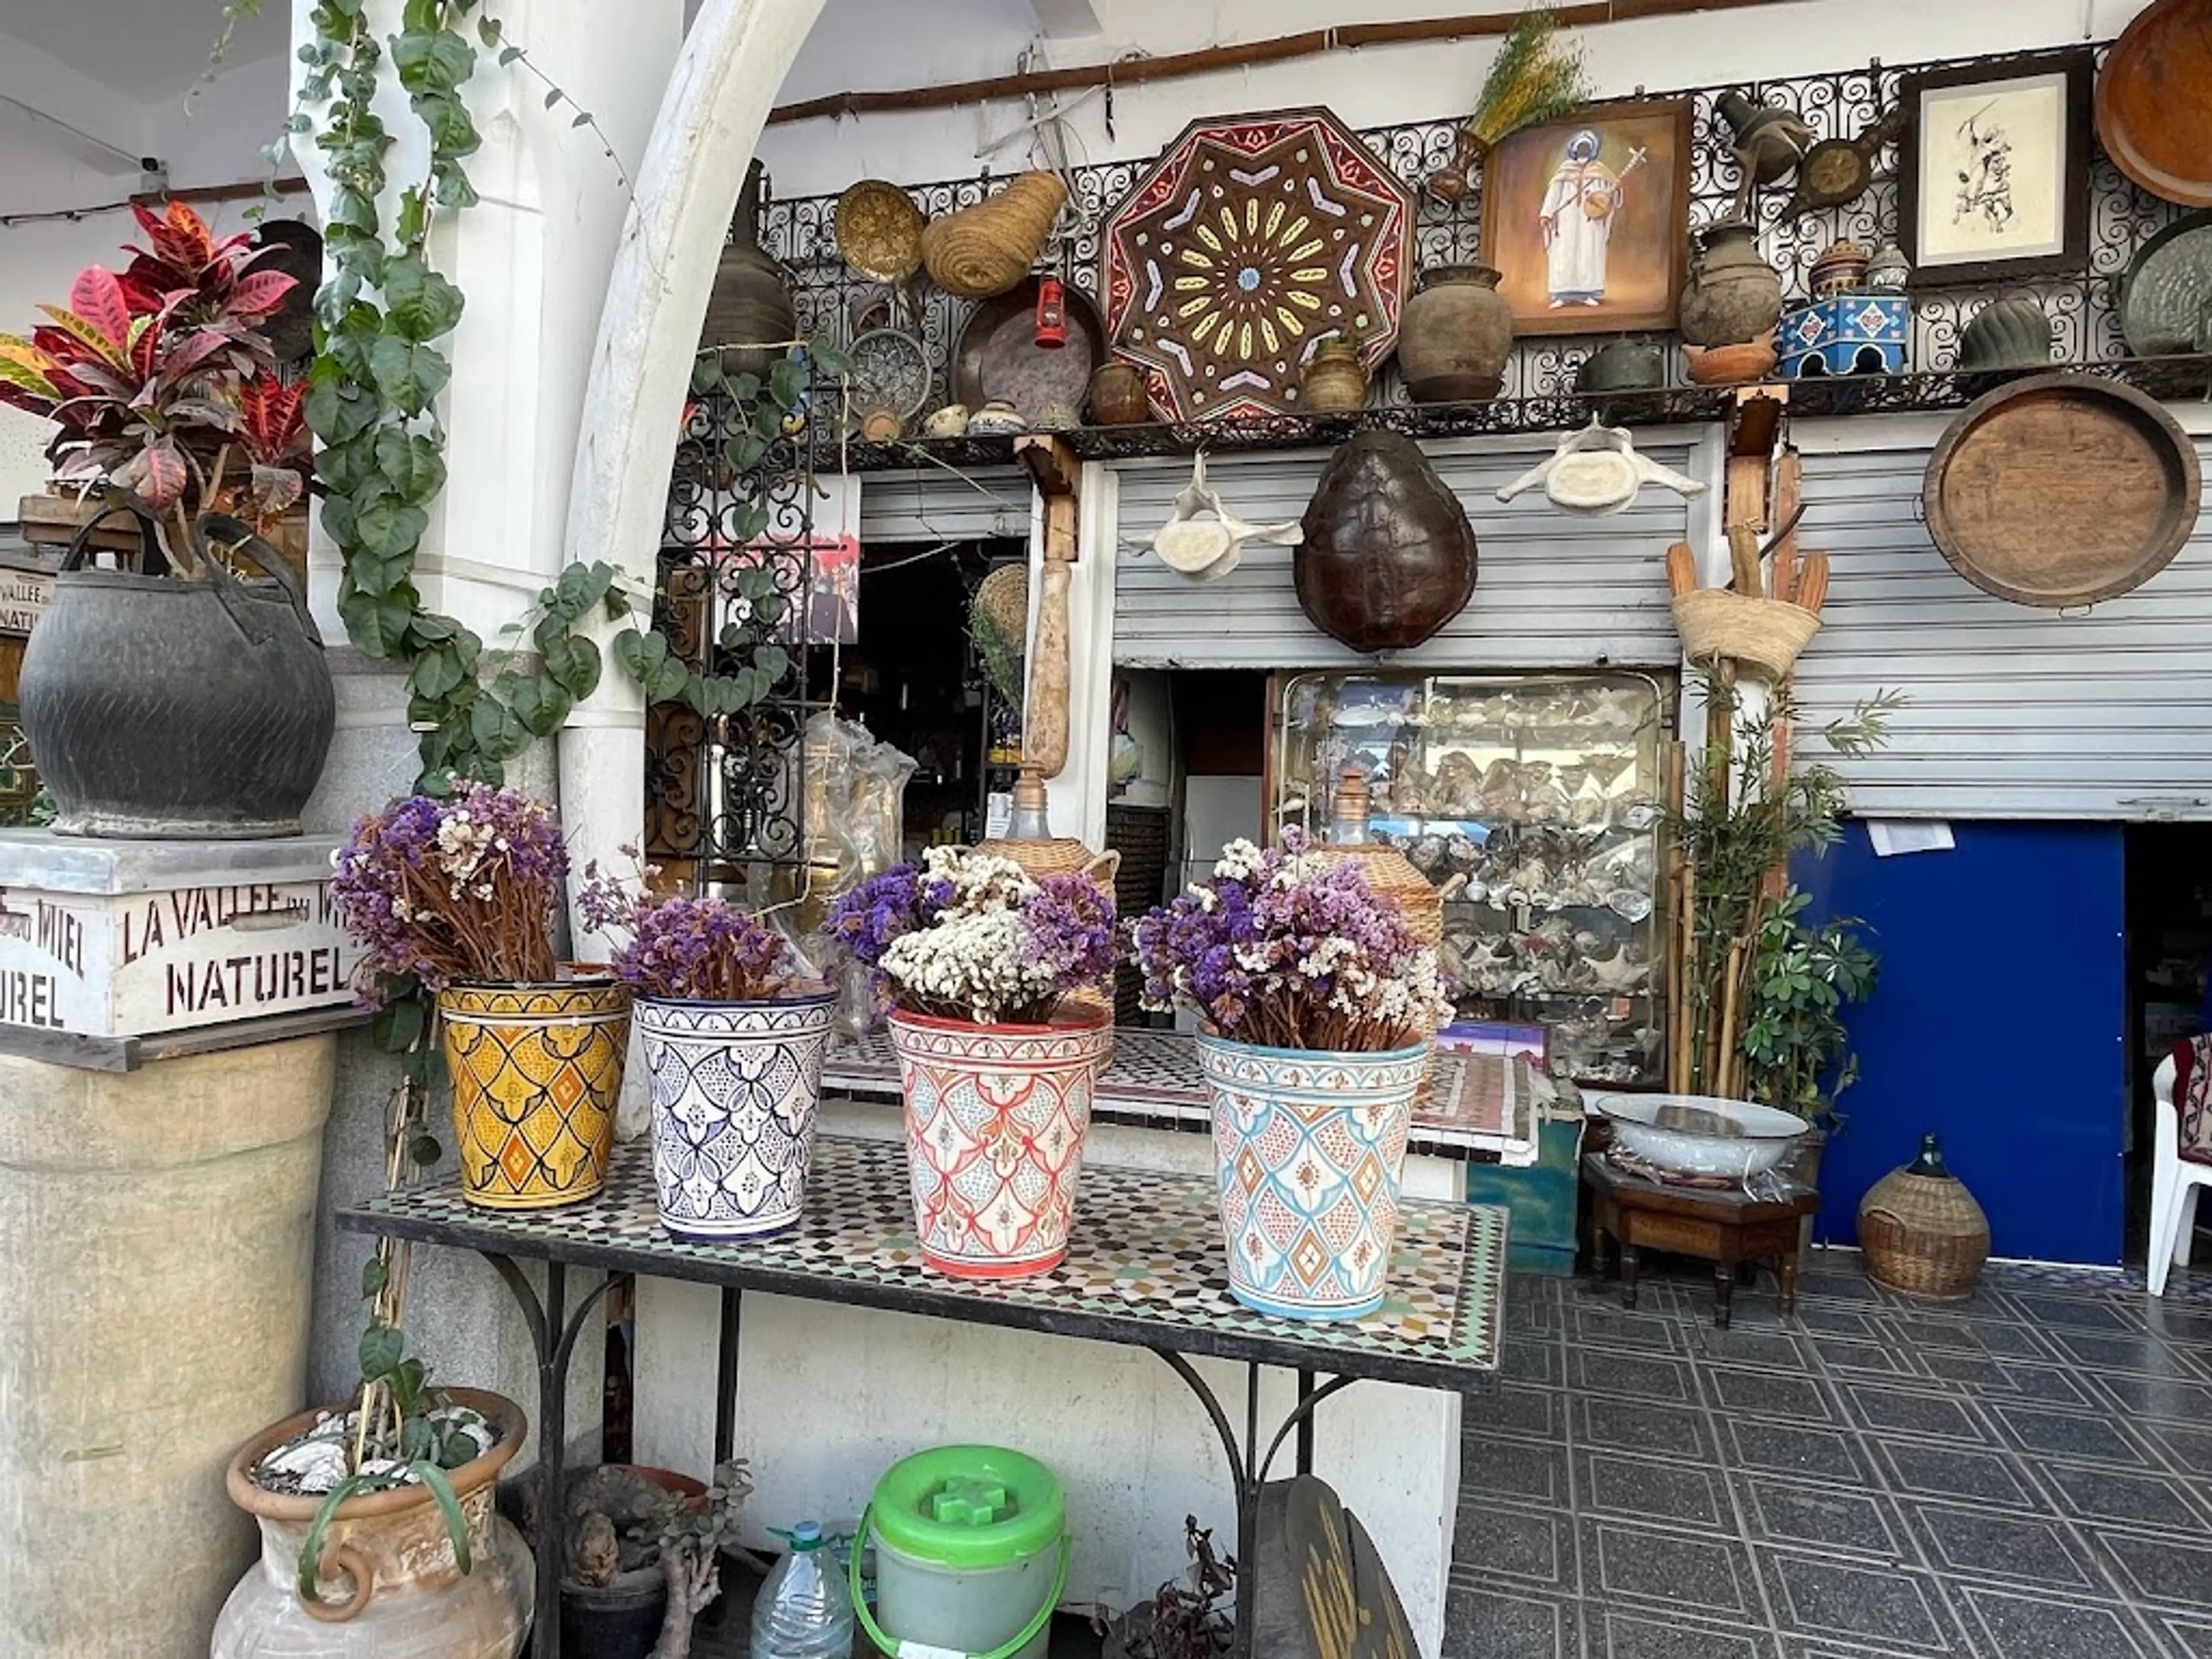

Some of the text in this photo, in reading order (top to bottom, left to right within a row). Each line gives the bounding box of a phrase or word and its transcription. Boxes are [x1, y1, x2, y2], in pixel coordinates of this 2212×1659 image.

[37, 898, 84, 981] MIEL
[124, 899, 164, 965] LA
[165, 947, 349, 1016] NATUREL
